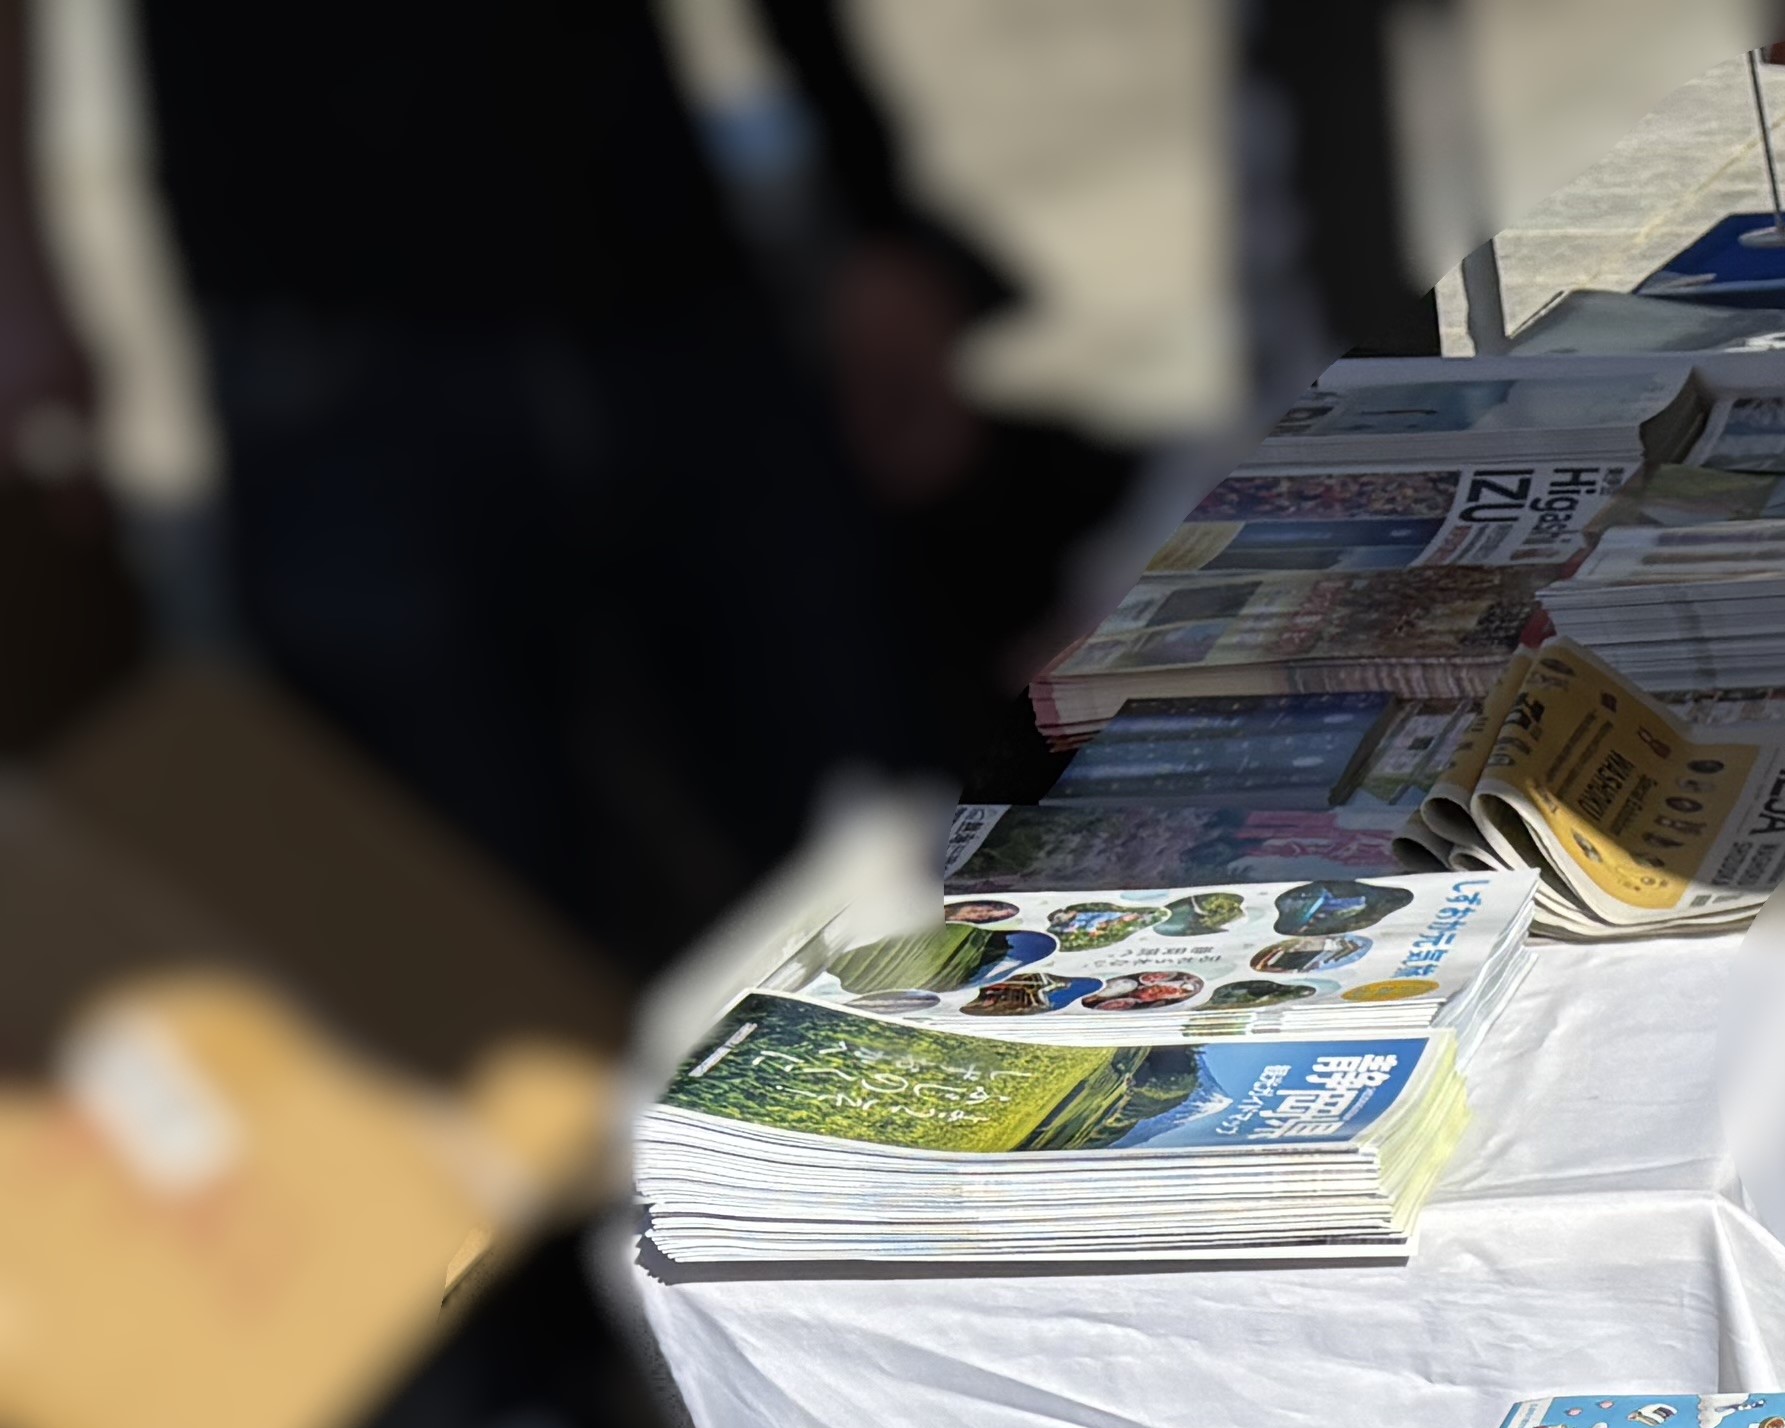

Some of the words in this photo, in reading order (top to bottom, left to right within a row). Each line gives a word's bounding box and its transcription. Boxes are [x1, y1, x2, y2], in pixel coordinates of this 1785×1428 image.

[1458, 469, 1535, 522] IZU
[1522, 468, 1600, 546] Higashi
[1249, 1055, 1398, 1139] 静岡県
